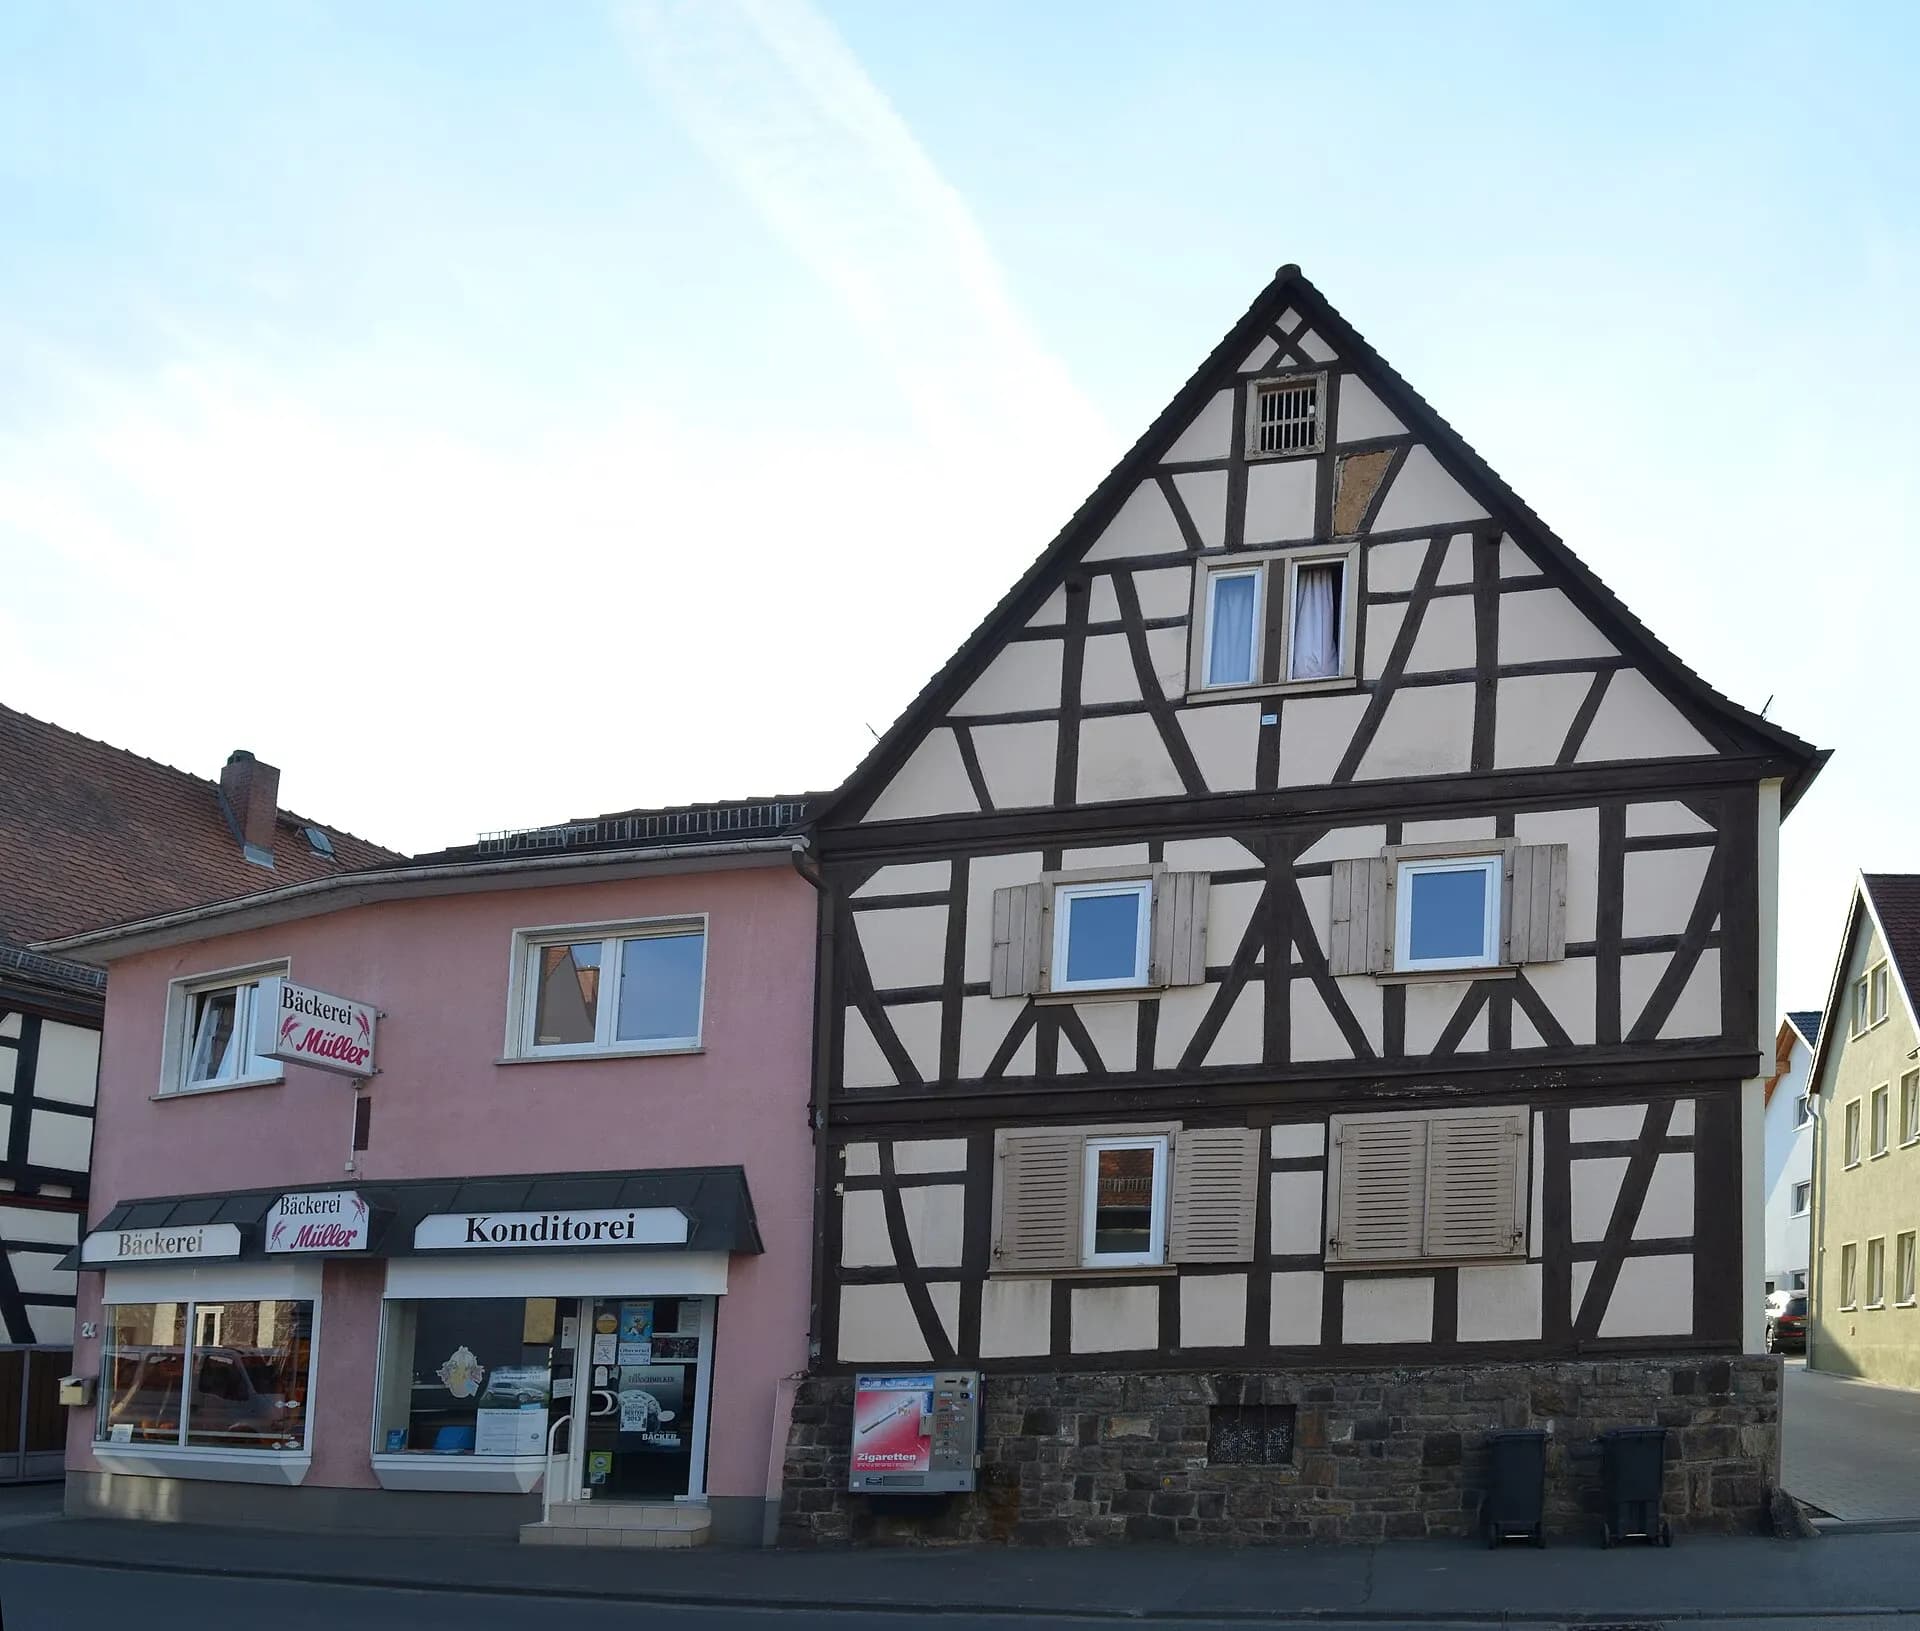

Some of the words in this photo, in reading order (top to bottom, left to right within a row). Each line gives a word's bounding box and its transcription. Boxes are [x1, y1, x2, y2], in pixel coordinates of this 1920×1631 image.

[282, 986, 352, 1026] Bäckerei
[295, 1027, 370, 1066] Müller
[280, 1194, 341, 1216] Bäckerei
[289, 1223, 358, 1249] Müller
[464, 1213, 636, 1243] Konditorei
[117, 1229, 204, 1257] Bäckerei
[857, 1453, 917, 1463] Zigaretten
